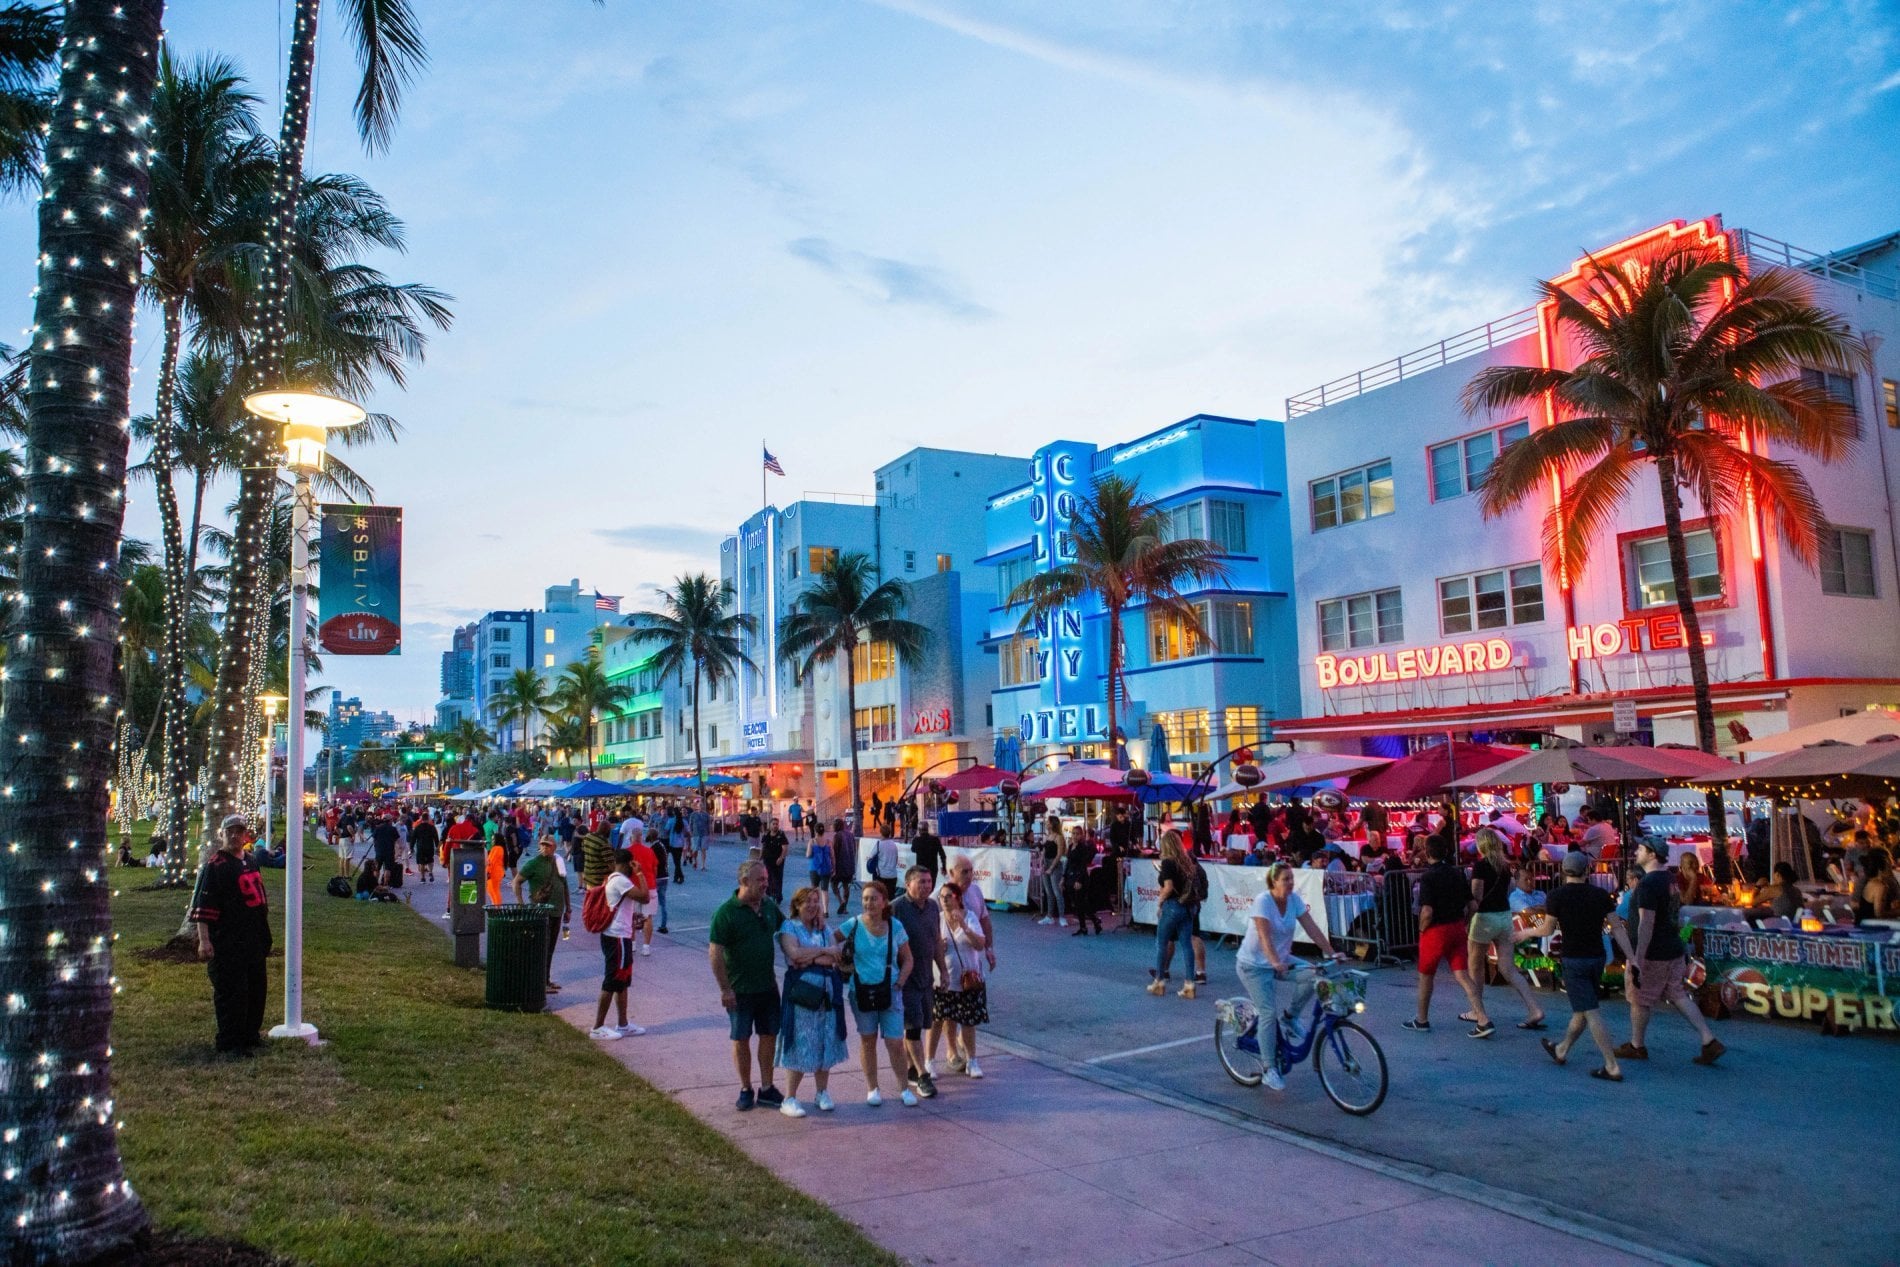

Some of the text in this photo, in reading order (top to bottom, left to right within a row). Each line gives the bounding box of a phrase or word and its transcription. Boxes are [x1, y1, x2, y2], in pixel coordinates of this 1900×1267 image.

[353, 517, 369, 608] #SBLIV
[1028, 454, 1050, 678] COLNY
[1057, 454, 1082, 677] COLNY
[1315, 639, 1513, 689] BOULEVARD
[744, 721, 768, 736] BEACON
[919, 709, 945, 732] CVS
[463, 863, 473, 876] P
[1704, 932, 1743, 958] IT'S
[1744, 936, 1802, 964] GAME
[1804, 941, 1863, 969] TIME!
[1743, 982, 1898, 1031] SUPER
